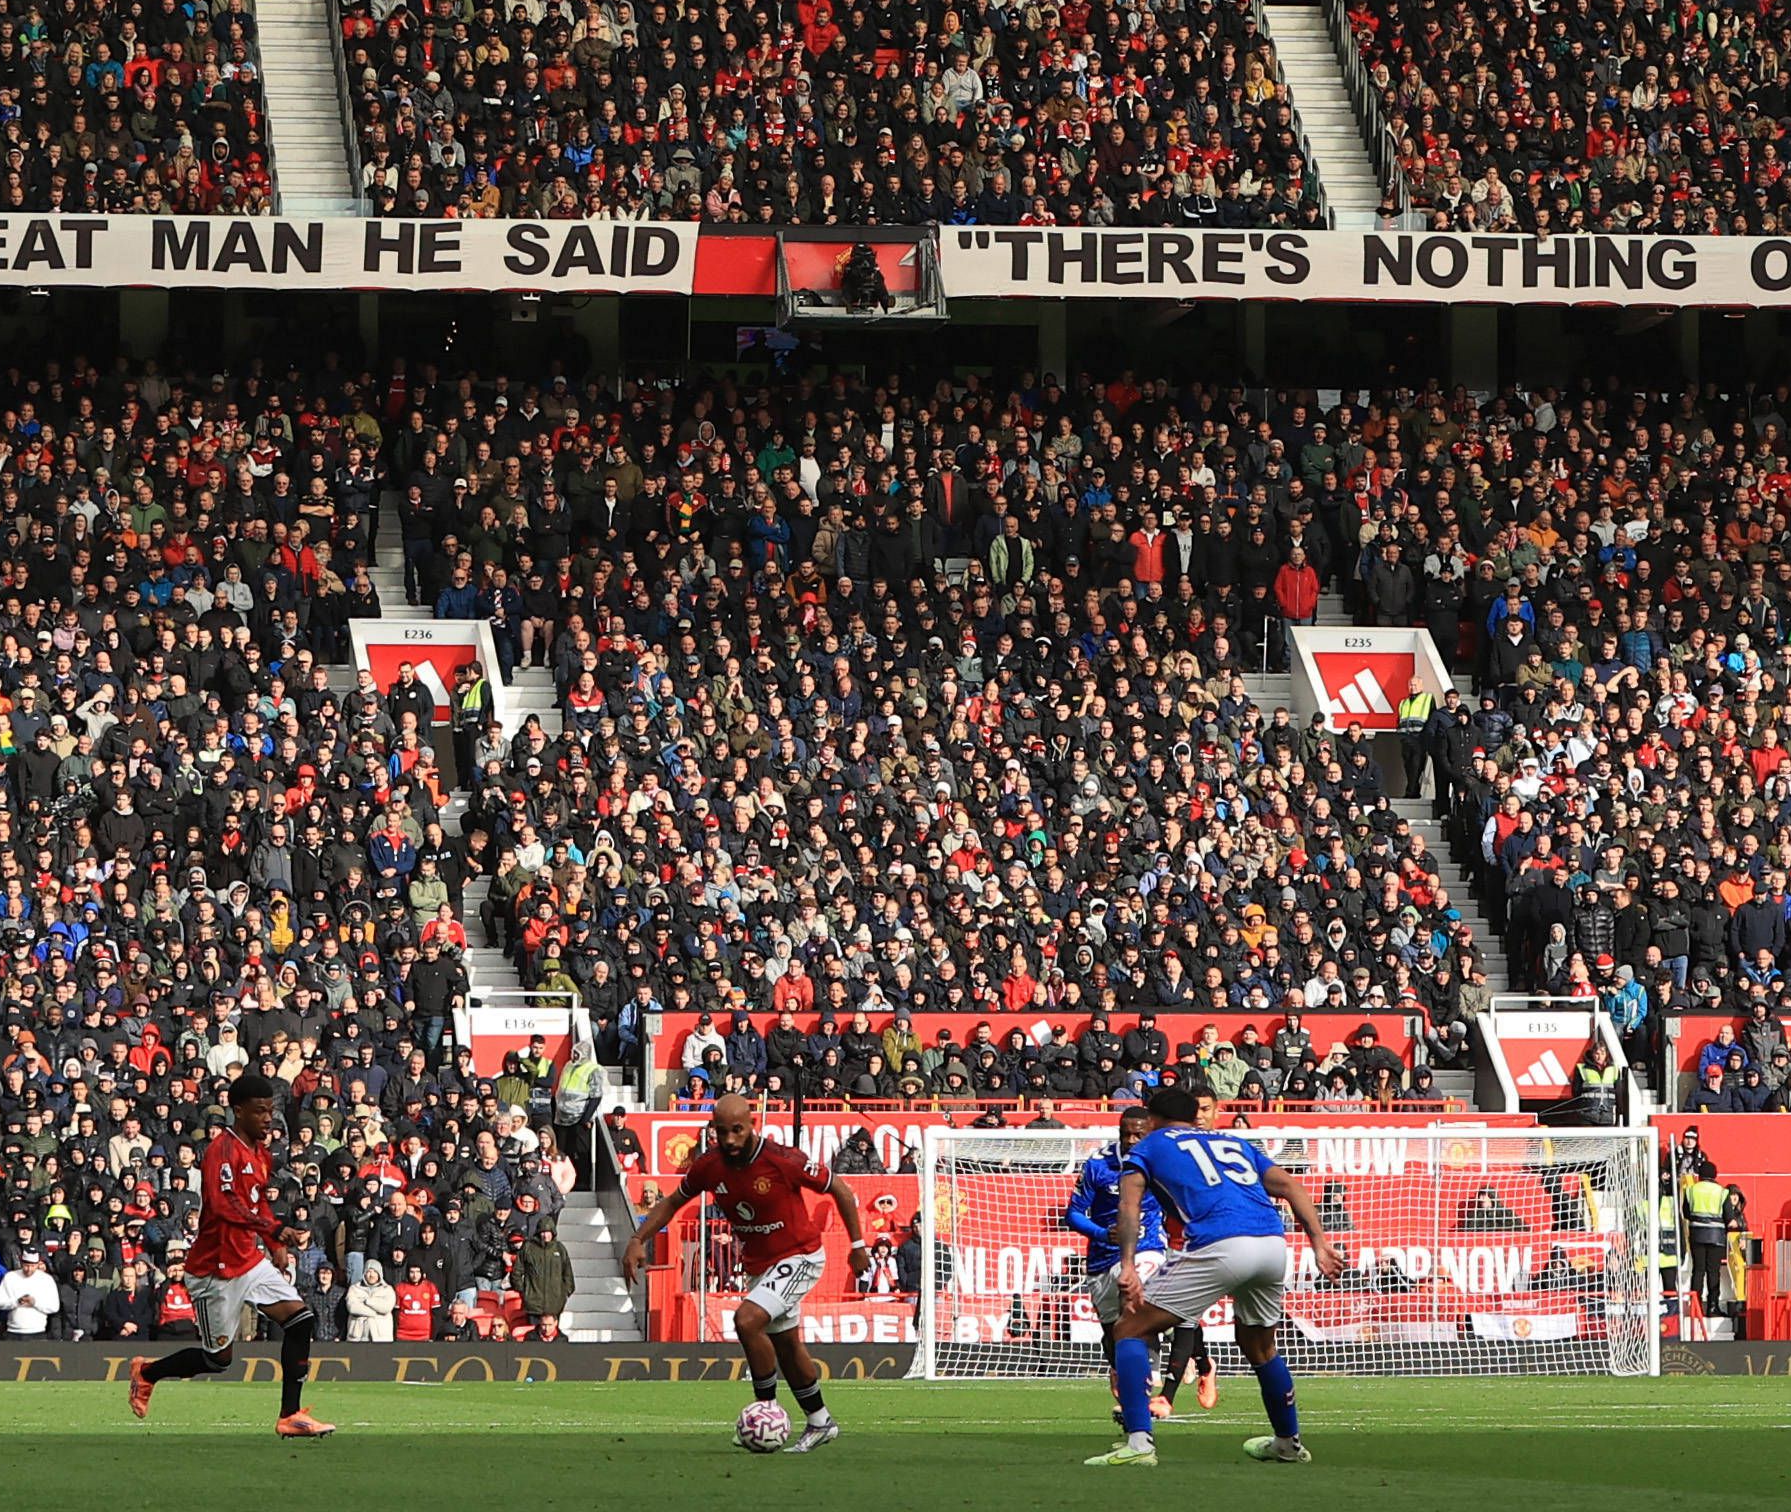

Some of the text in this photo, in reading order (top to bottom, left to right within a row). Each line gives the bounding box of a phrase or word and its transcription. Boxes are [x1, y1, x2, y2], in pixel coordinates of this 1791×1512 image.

[152, 220, 323, 274] MAN
[364, 221, 462, 274] HE
[504, 224, 679, 277] SAID
[958, 231, 1310, 284] "THERE'S
[1364, 235, 1696, 290] NOTHING
[405, 629, 433, 639] E236
[1345, 638, 1371, 649] E235
[505, 1018, 535, 1029] E136
[1528, 1023, 1557, 1033] E135
[1176, 1139, 1258, 1187] 15
[1441, 1246, 1534, 1294] NOW
